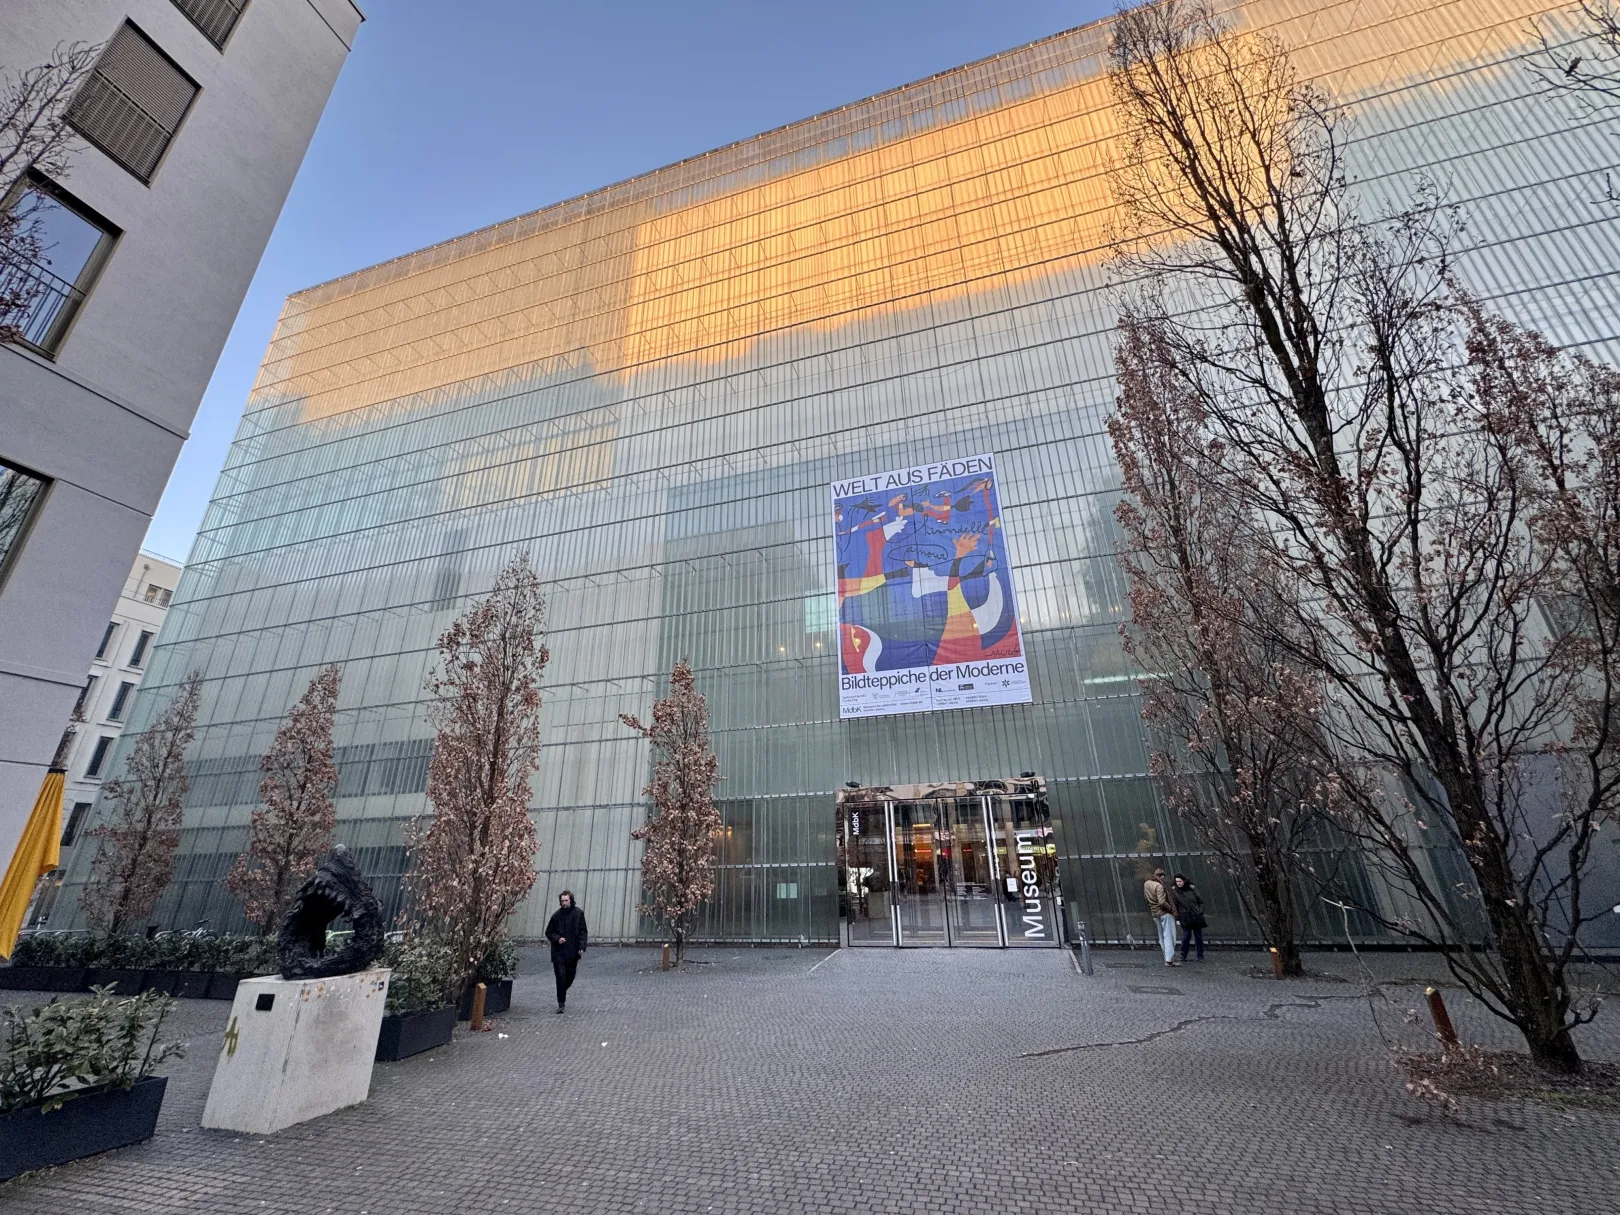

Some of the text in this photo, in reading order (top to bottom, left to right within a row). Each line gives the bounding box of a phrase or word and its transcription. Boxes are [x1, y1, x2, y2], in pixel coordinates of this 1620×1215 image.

[832, 456, 993, 498] WELT AUS FÄDEN
[924, 513, 988, 536] hirondelle
[906, 546, 949, 561] amour
[841, 661, 1025, 691] Bildteppiche der Moderne
[842, 706, 862, 714] MdbK
[851, 811, 860, 836] MdbK
[1016, 833, 1046, 938] Museum
